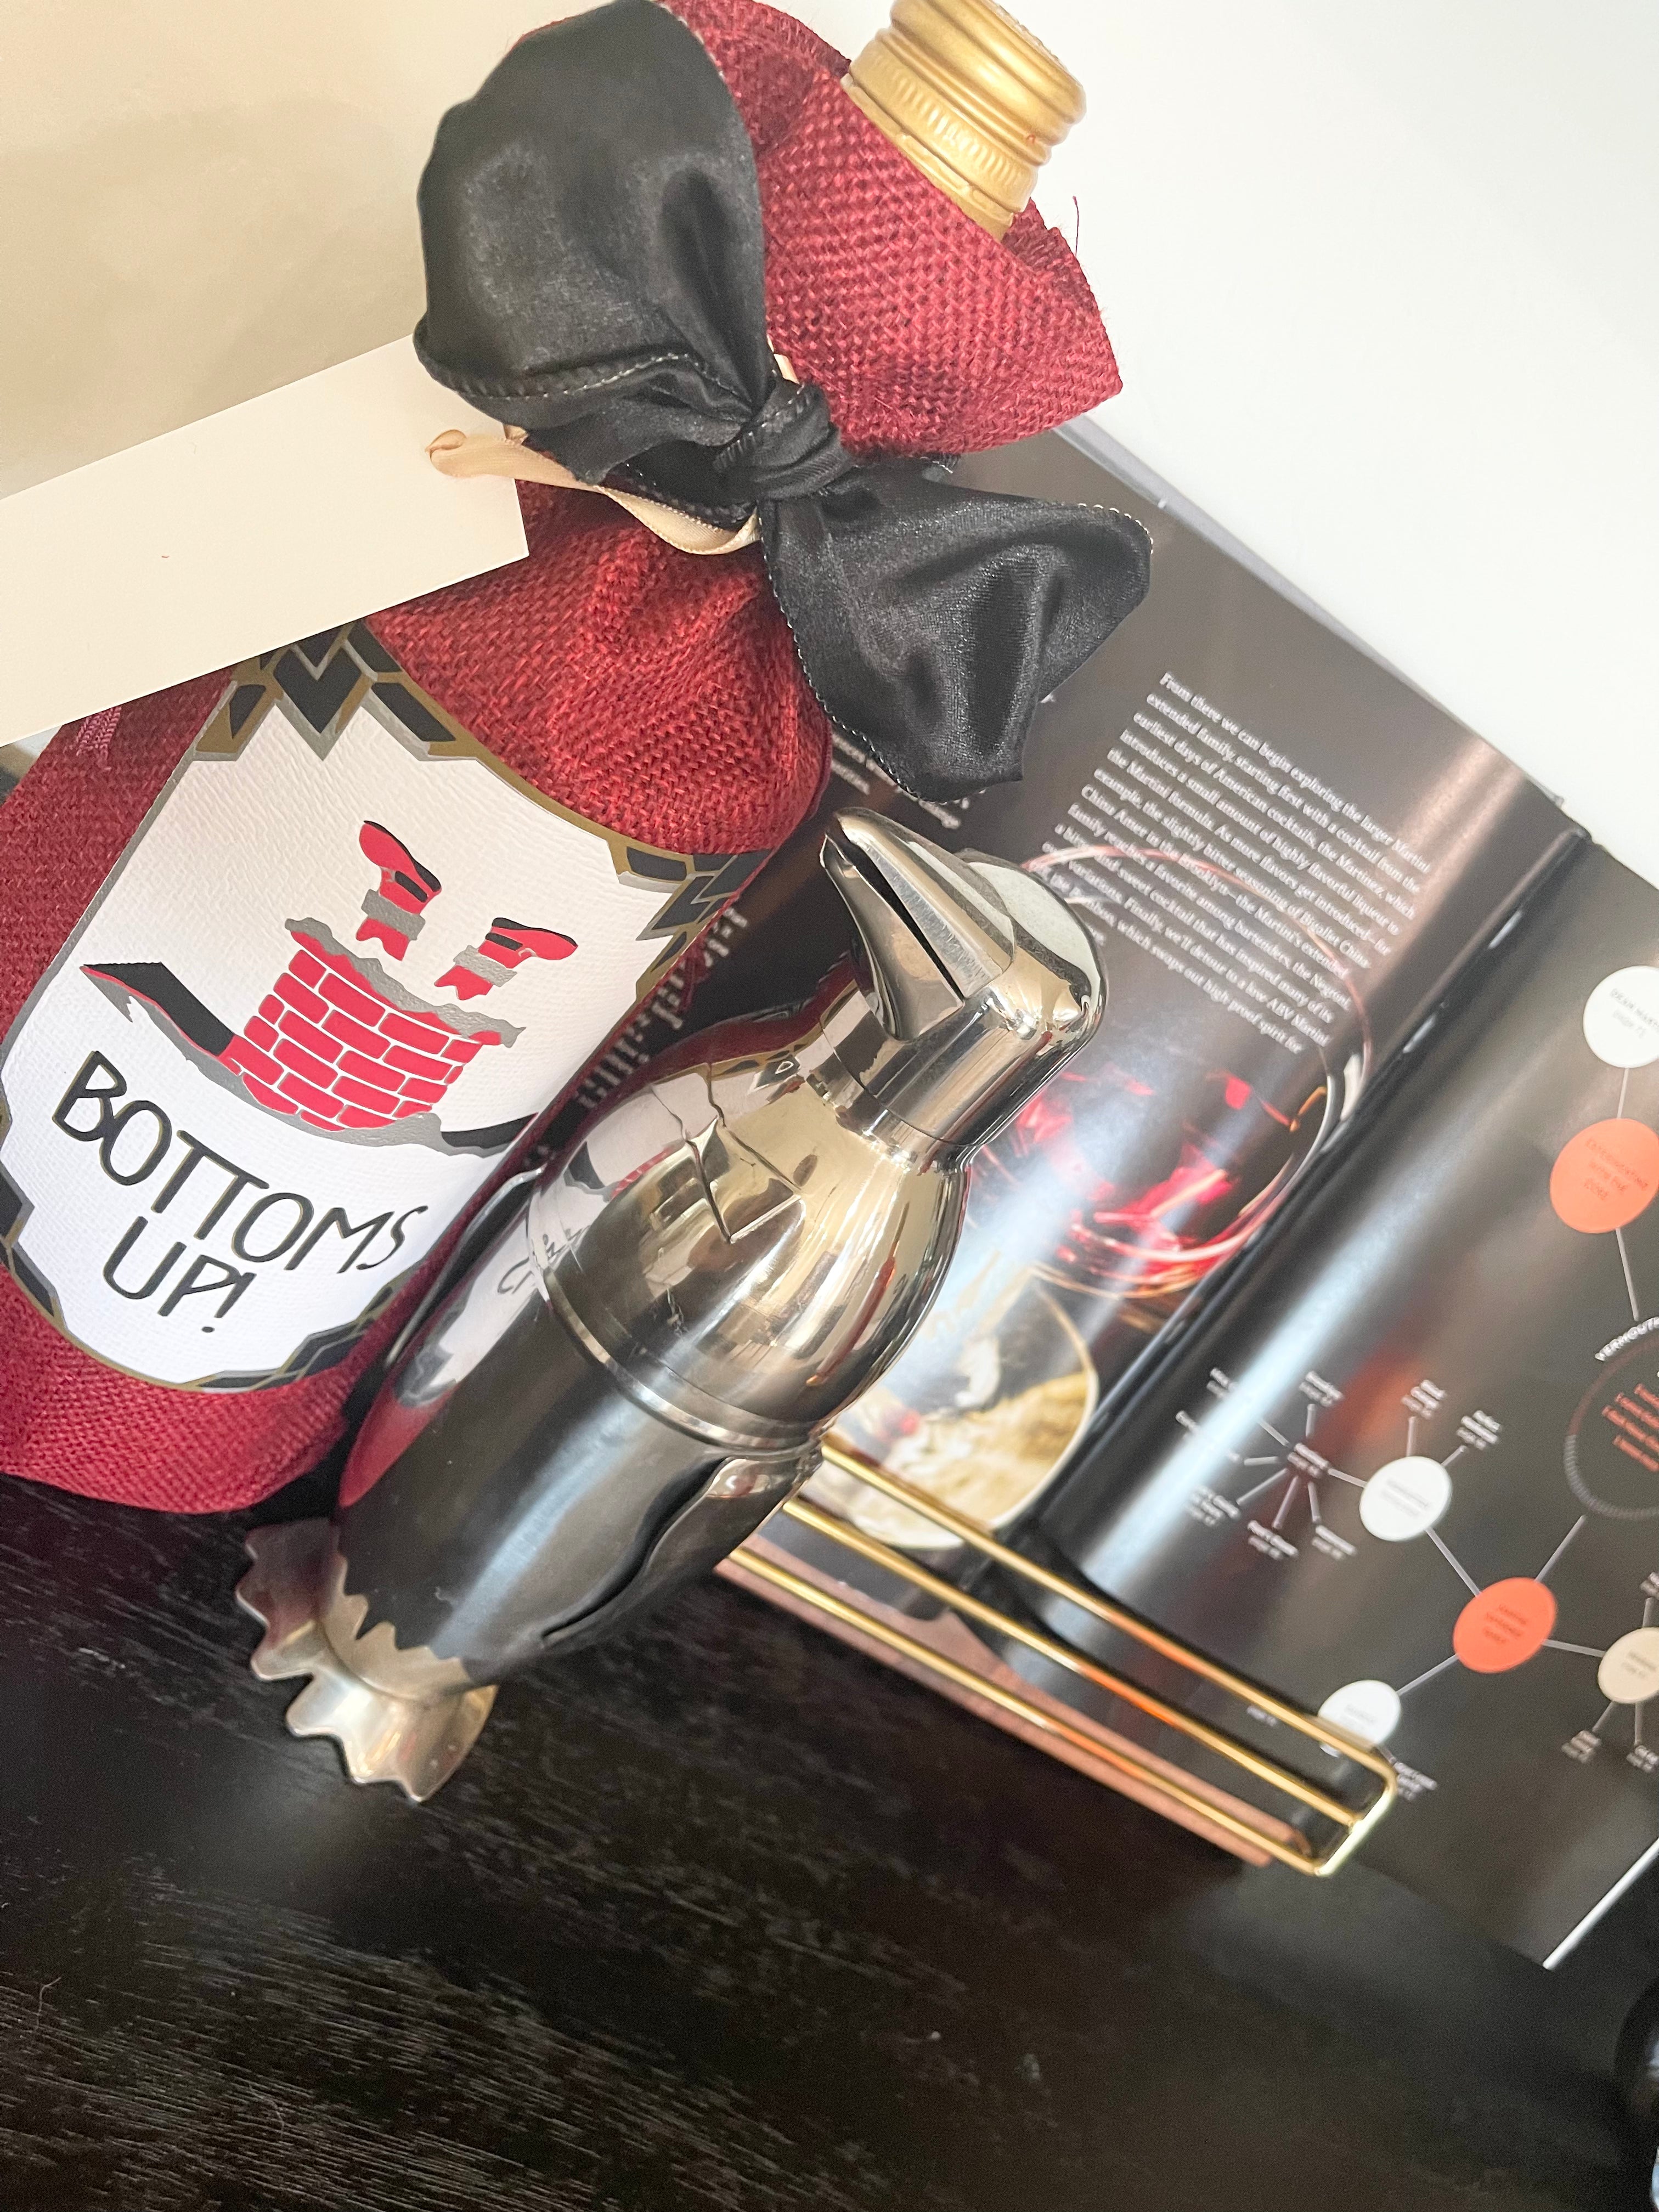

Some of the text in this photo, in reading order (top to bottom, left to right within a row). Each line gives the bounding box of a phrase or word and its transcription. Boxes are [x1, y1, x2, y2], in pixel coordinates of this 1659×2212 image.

[1081, 784, 1115, 815] China
[1114, 809, 1148, 837] Amer
[1107, 747, 1128, 768] the
[1126, 761, 1171, 798] Martini
[1230, 838, 1261, 862] more
[1259, 856, 1297, 889] flavors
[1294, 884, 1316, 901] get
[1120, 729, 1178, 777] introduces
[1186, 778, 1220, 804] small
[1216, 800, 1262, 834] amount
[1272, 836, 1310, 870] highly
[1307, 862, 1356, 901] flavorful
[1352, 894, 1389, 927] liqueur
[1133, 713, 1177, 746] earliest
[1174, 741, 1201, 765] days
[1213, 768, 1268, 812] American
[1317, 842, 1337, 861] the
[1385, 892, 1421, 919] which
[1147, 693, 1201, 733] extended
[1234, 755, 1280, 794] starting
[1278, 785, 1304, 808] first
[1302, 804, 1328, 827] with
[1336, 828, 1381, 863] cocktail
[1377, 857, 1403, 882] from
[1402, 877, 1424, 894] the
[1159, 672, 1192, 702] From
[1190, 695, 1222, 722] there
[1238, 730, 1260, 750] can
[1259, 742, 1291, 772] begin
[1290, 768, 1344, 811] exploring
[1342, 803, 1361, 822] the
[1360, 815, 1393, 844] larger
[1391, 838, 1431, 873] Martini
[1068, 803, 1106, 836] family
[1154, 864, 1197, 900] favorite
[1196, 897, 1235, 929] among
[1293, 962, 1311, 979] the
[1142, 801, 1162, 821] the
[1161, 817, 1204, 851] slightly
[1202, 841, 1239, 872] bitter
[1231, 863, 1293, 913] seasoning
[1067, 887, 1118, 927] Bmboo,
[1117, 920, 1154, 951] which
[1150, 945, 1184, 972] swaps
[1184, 968, 1204, 986] out
[1258, 1020, 1286, 1043] spirit
[1284, 1036, 1304, 1053] for
[1118, 868, 1152, 895] sweet
[1150, 890, 1195, 924] cocktail
[1193, 919, 1218, 941] that
[1215, 934, 1236, 955] has
[1235, 949, 1281, 985] inspired
[1278, 980, 1308, 1006] many
[1318, 1006, 1334, 1023] its
[1190, 945, 1226, 974] detour
[1291, 1014, 1334, 1046] Martini
[52, 1051, 428, 1274] BOTTOMS
[103, 1216, 257, 1333] UP!
